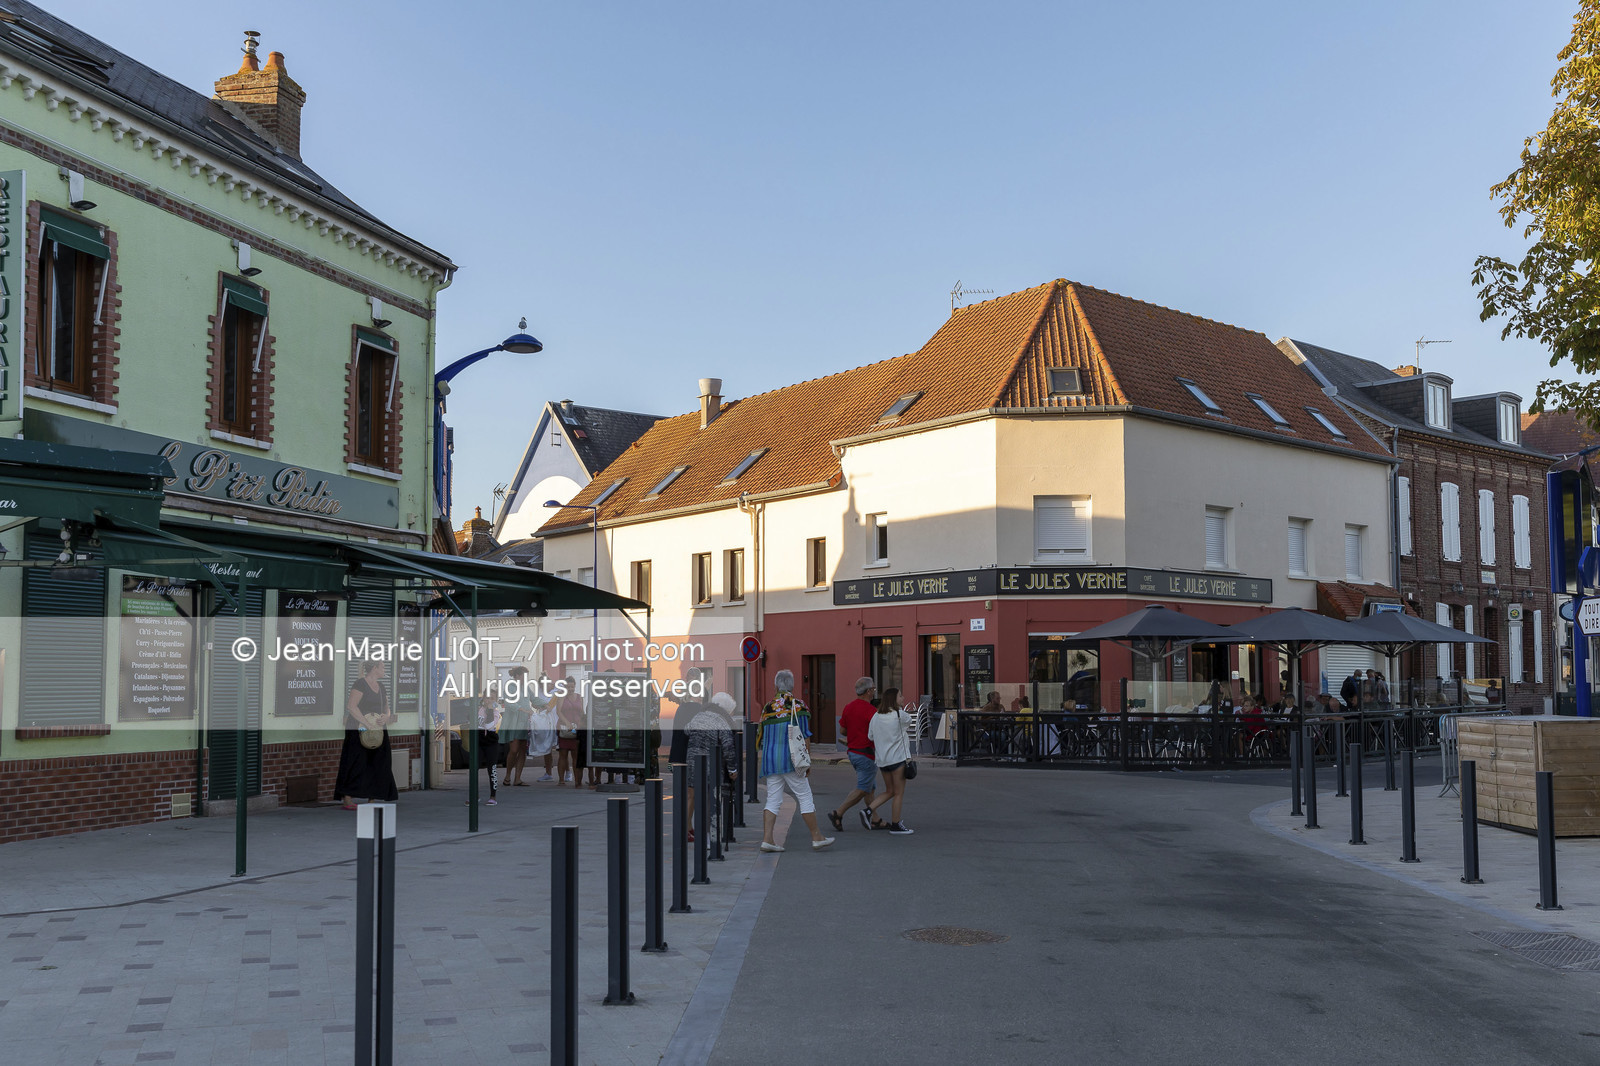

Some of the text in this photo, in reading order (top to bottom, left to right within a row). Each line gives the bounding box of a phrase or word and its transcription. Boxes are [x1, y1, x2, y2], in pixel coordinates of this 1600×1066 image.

[187, 449, 266, 501] P'tit
[268, 467, 342, 515] Ridin
[208, 562, 264, 579] Restauant
[873, 577, 949, 598] LE JULES VERNE
[1000, 572, 1127, 590] LE JULES VERNE
[1169, 576, 1237, 597] LE JULES VERNE
[132, 580, 190, 597] Le P'tit Ridin
[285, 597, 295, 609] Le
[292, 621, 321, 631] POISSONS
[136, 639, 150, 648] Curry
[296, 670, 316, 678] PLATS
[288, 679, 323, 689] RÉGIONAUX
[294, 696, 316, 705] MENUS
